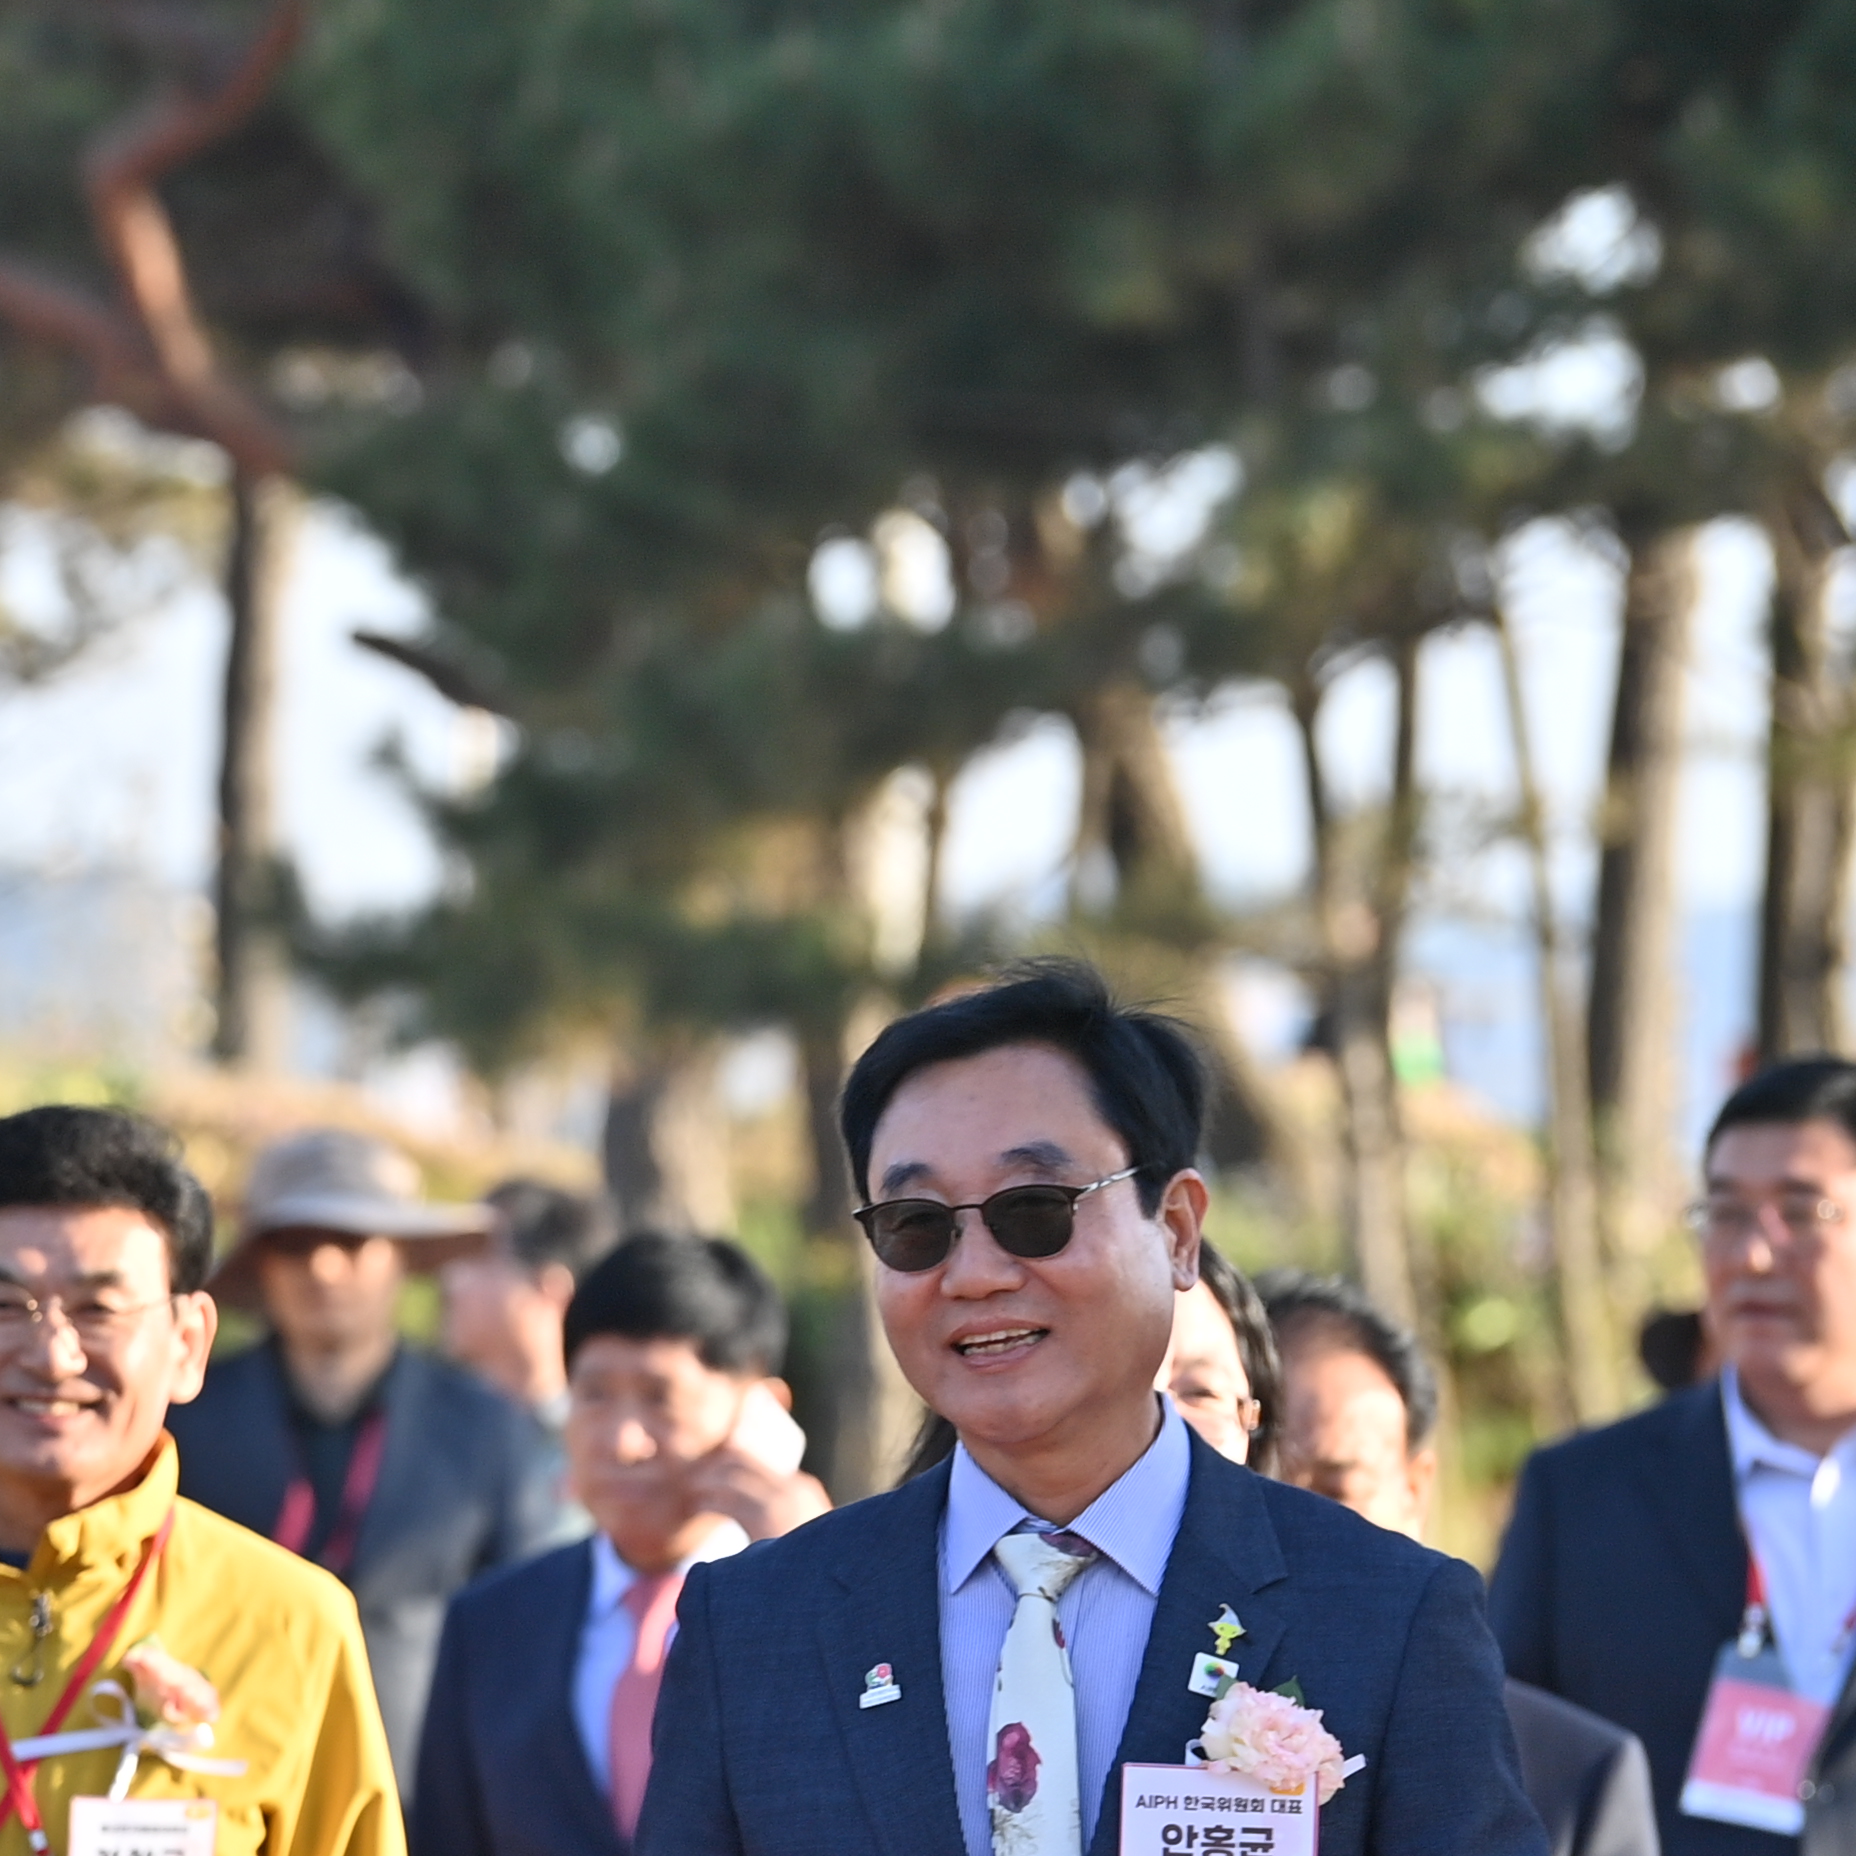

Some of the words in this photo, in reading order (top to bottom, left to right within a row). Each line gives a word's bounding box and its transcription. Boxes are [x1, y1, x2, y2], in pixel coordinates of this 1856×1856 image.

[1135, 1794, 1178, 1811] AIPH
[1183, 1795, 1265, 1814] 한국위원회
[1270, 1798, 1304, 1815] 대표
